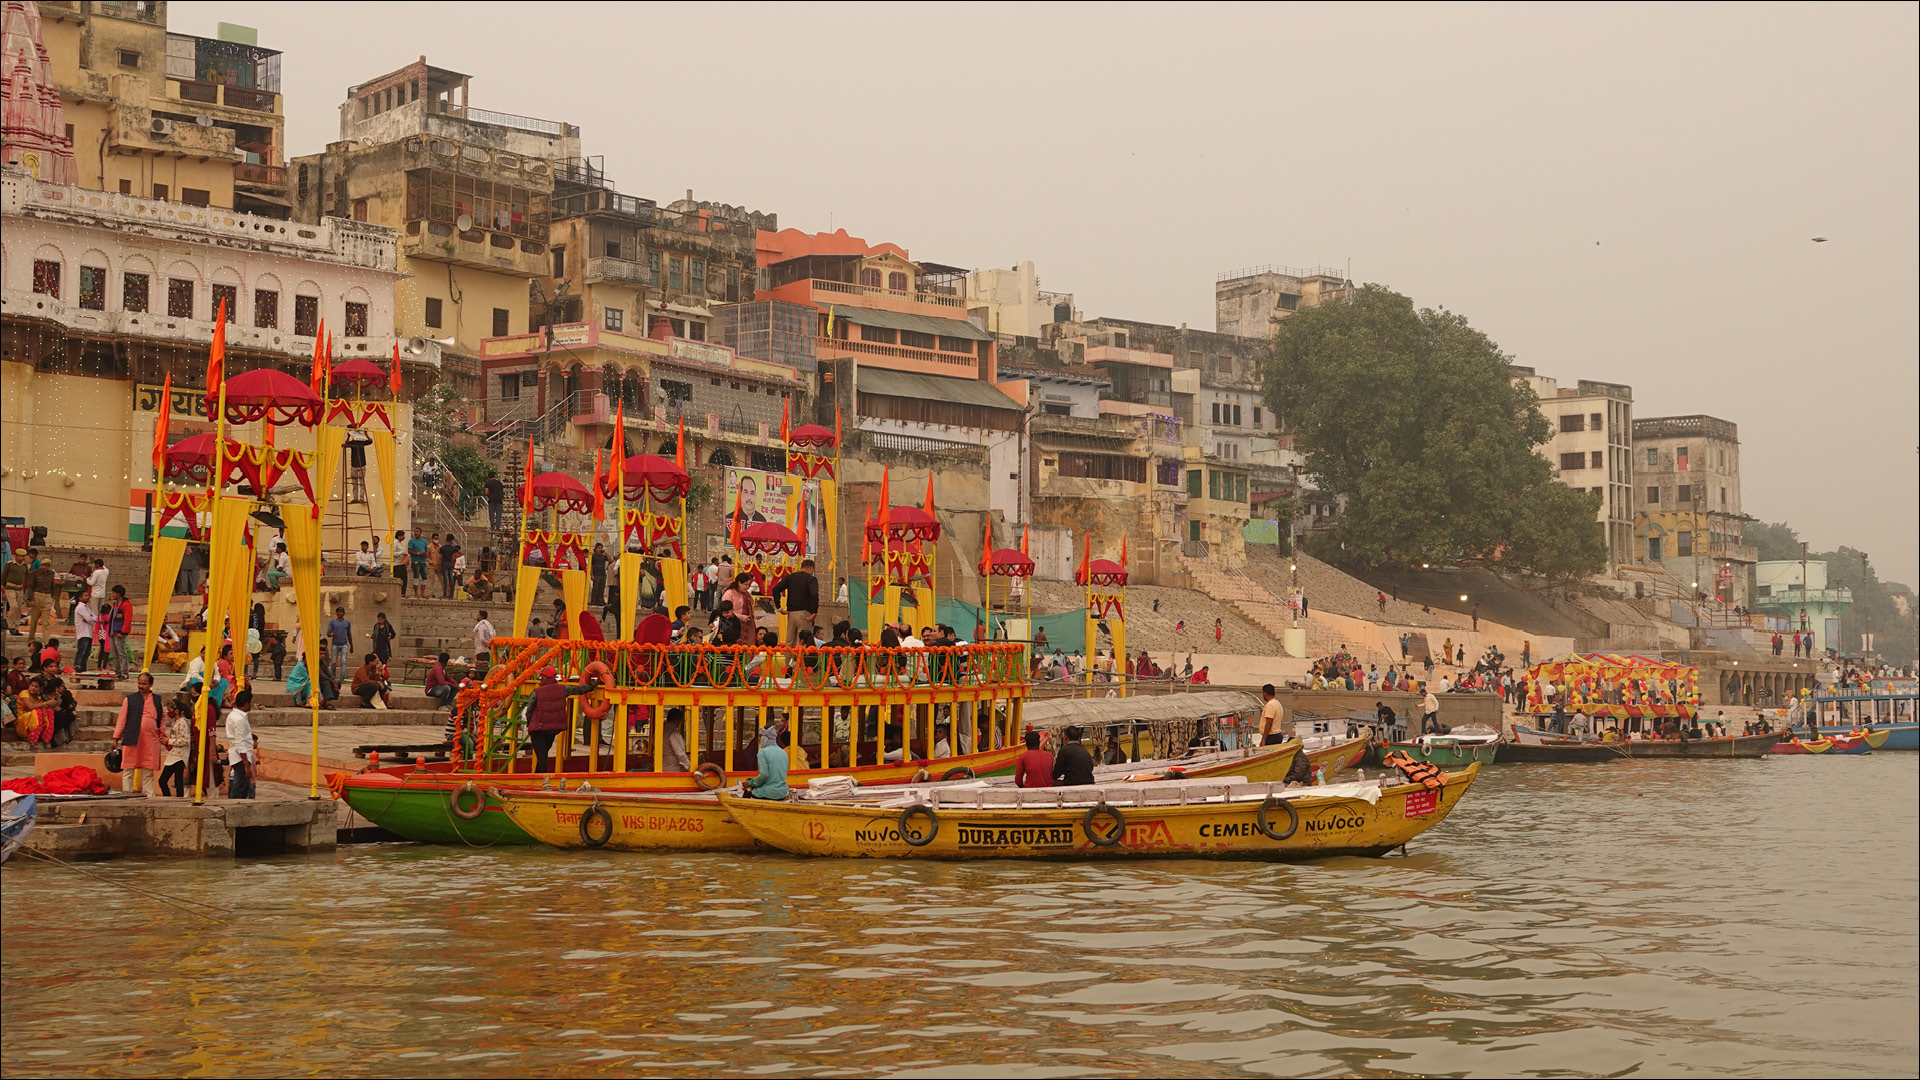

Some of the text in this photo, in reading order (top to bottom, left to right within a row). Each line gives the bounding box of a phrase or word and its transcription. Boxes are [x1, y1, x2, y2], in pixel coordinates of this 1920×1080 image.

[622, 815, 645, 830] VNS
[649, 816, 666, 831] BP
[668, 817, 704, 833] A263
[808, 821, 826, 841] 12
[1305, 815, 1365, 832] NUVOCO
[855, 826, 922, 841] NUVOO
[958, 828, 1073, 845] DURAGUARD
